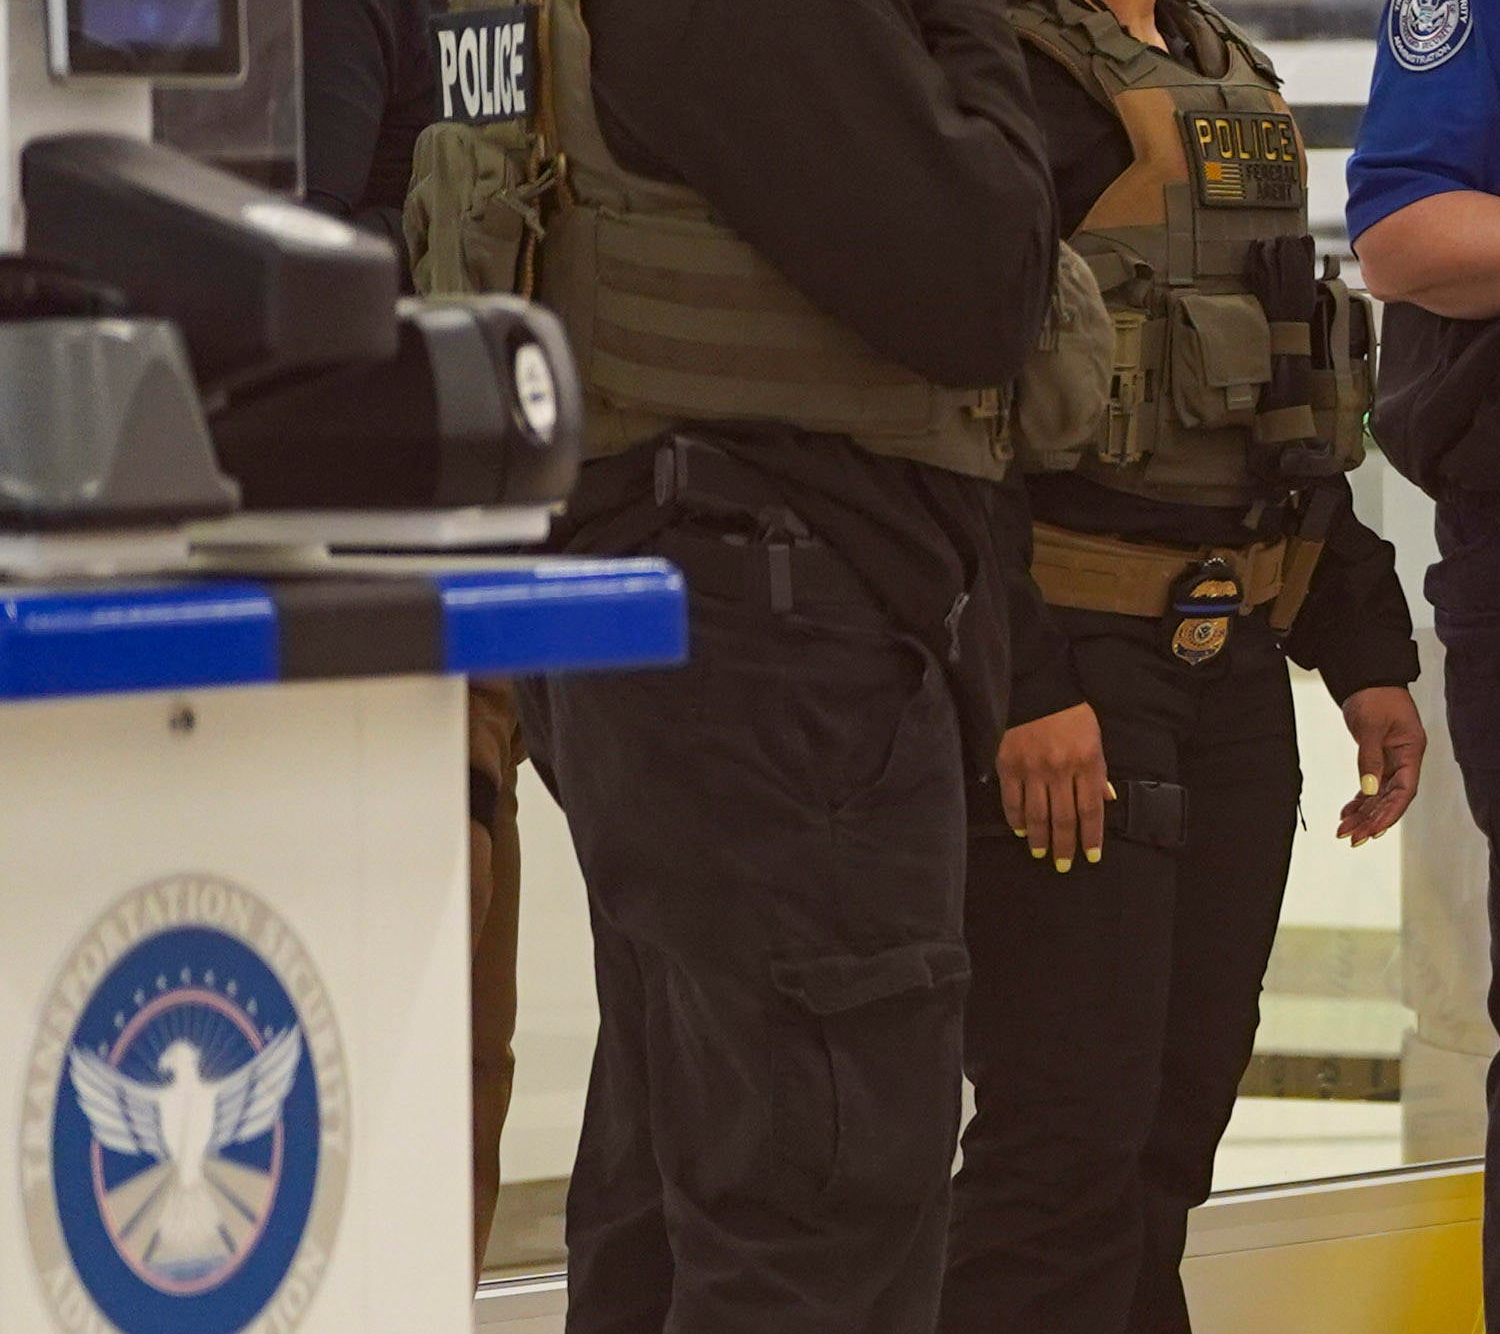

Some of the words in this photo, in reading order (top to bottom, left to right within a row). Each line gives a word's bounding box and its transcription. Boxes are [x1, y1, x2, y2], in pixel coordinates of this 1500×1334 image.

[438, 23, 526, 119] POLICE
[1195, 118, 1297, 162] POLICE
[25, 883, 254, 1184] TRANSPORTATION
[262, 911, 345, 1150] SECURITY
